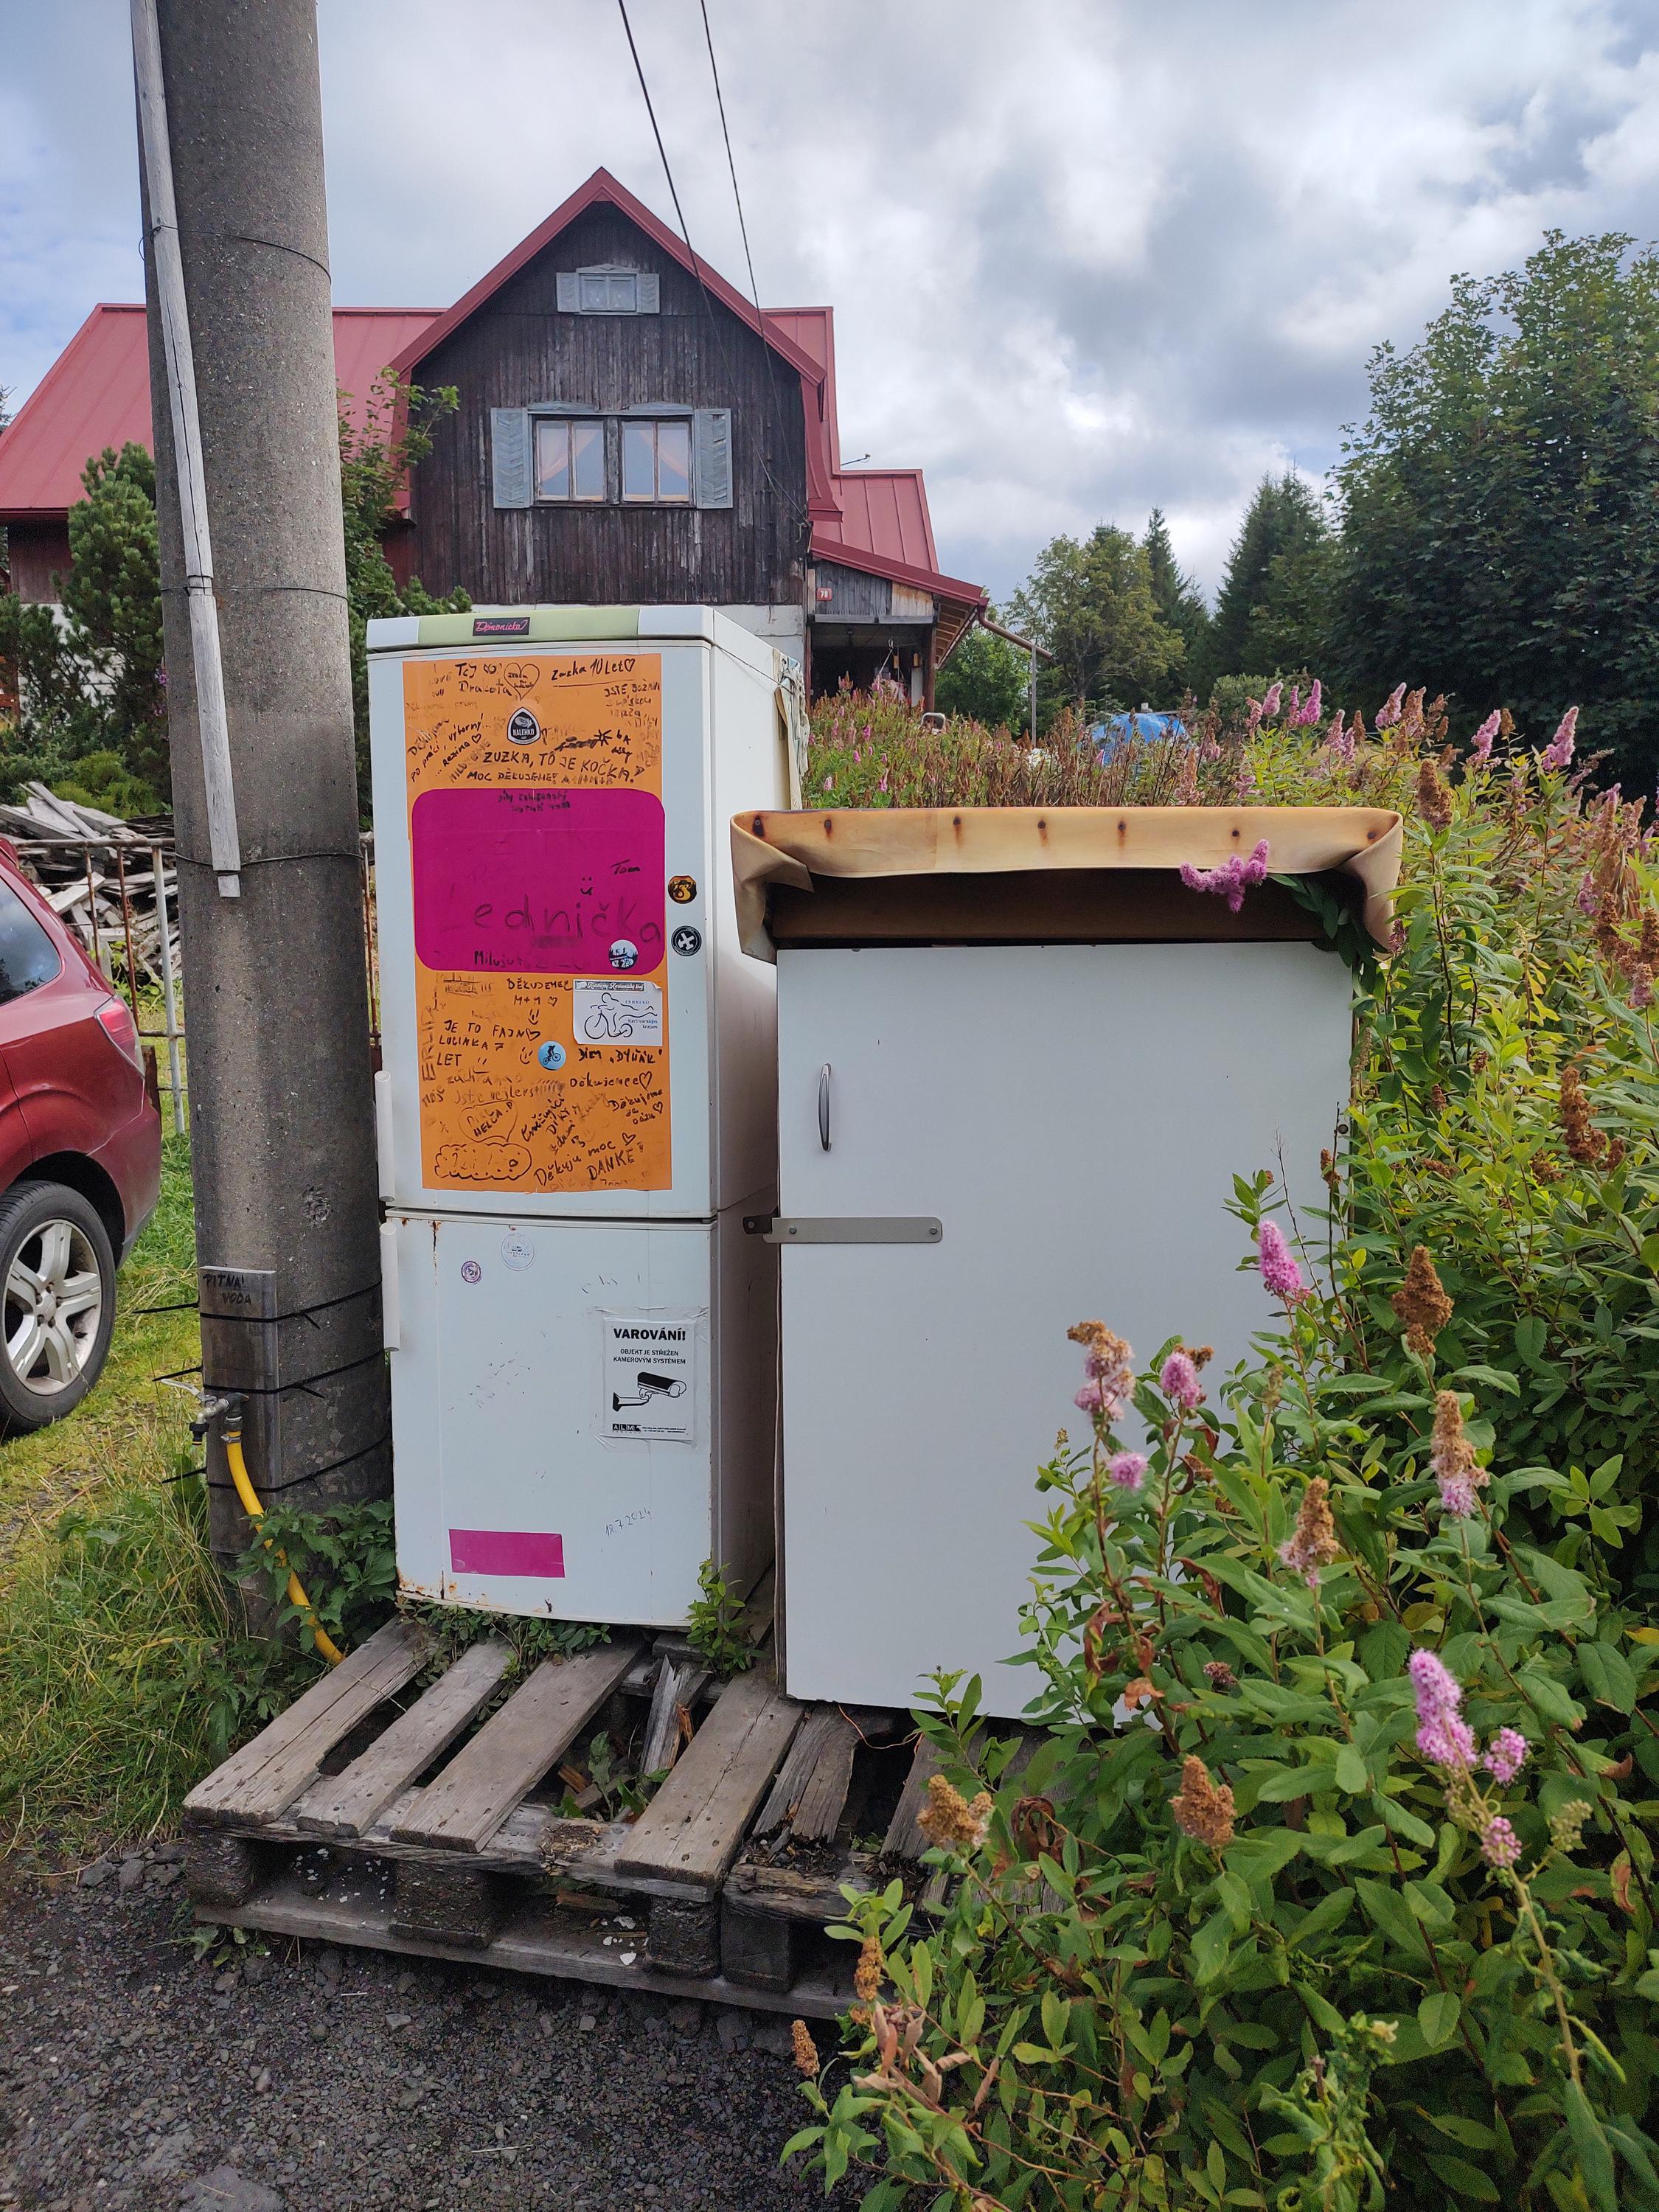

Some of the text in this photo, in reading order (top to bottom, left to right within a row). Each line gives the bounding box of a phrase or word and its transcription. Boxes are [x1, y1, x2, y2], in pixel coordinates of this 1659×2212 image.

[467, 771, 493, 782] MOC
[468, 1023, 481, 1033] TO
[437, 1052, 462, 1067] LET
[613, 1327, 686, 1341] VAROVÁNÍ!
[651, 1349, 679, 1357] STŘEŽEN
[613, 1356, 686, 1366] KAMEROVÝM SYSTÉMEM
